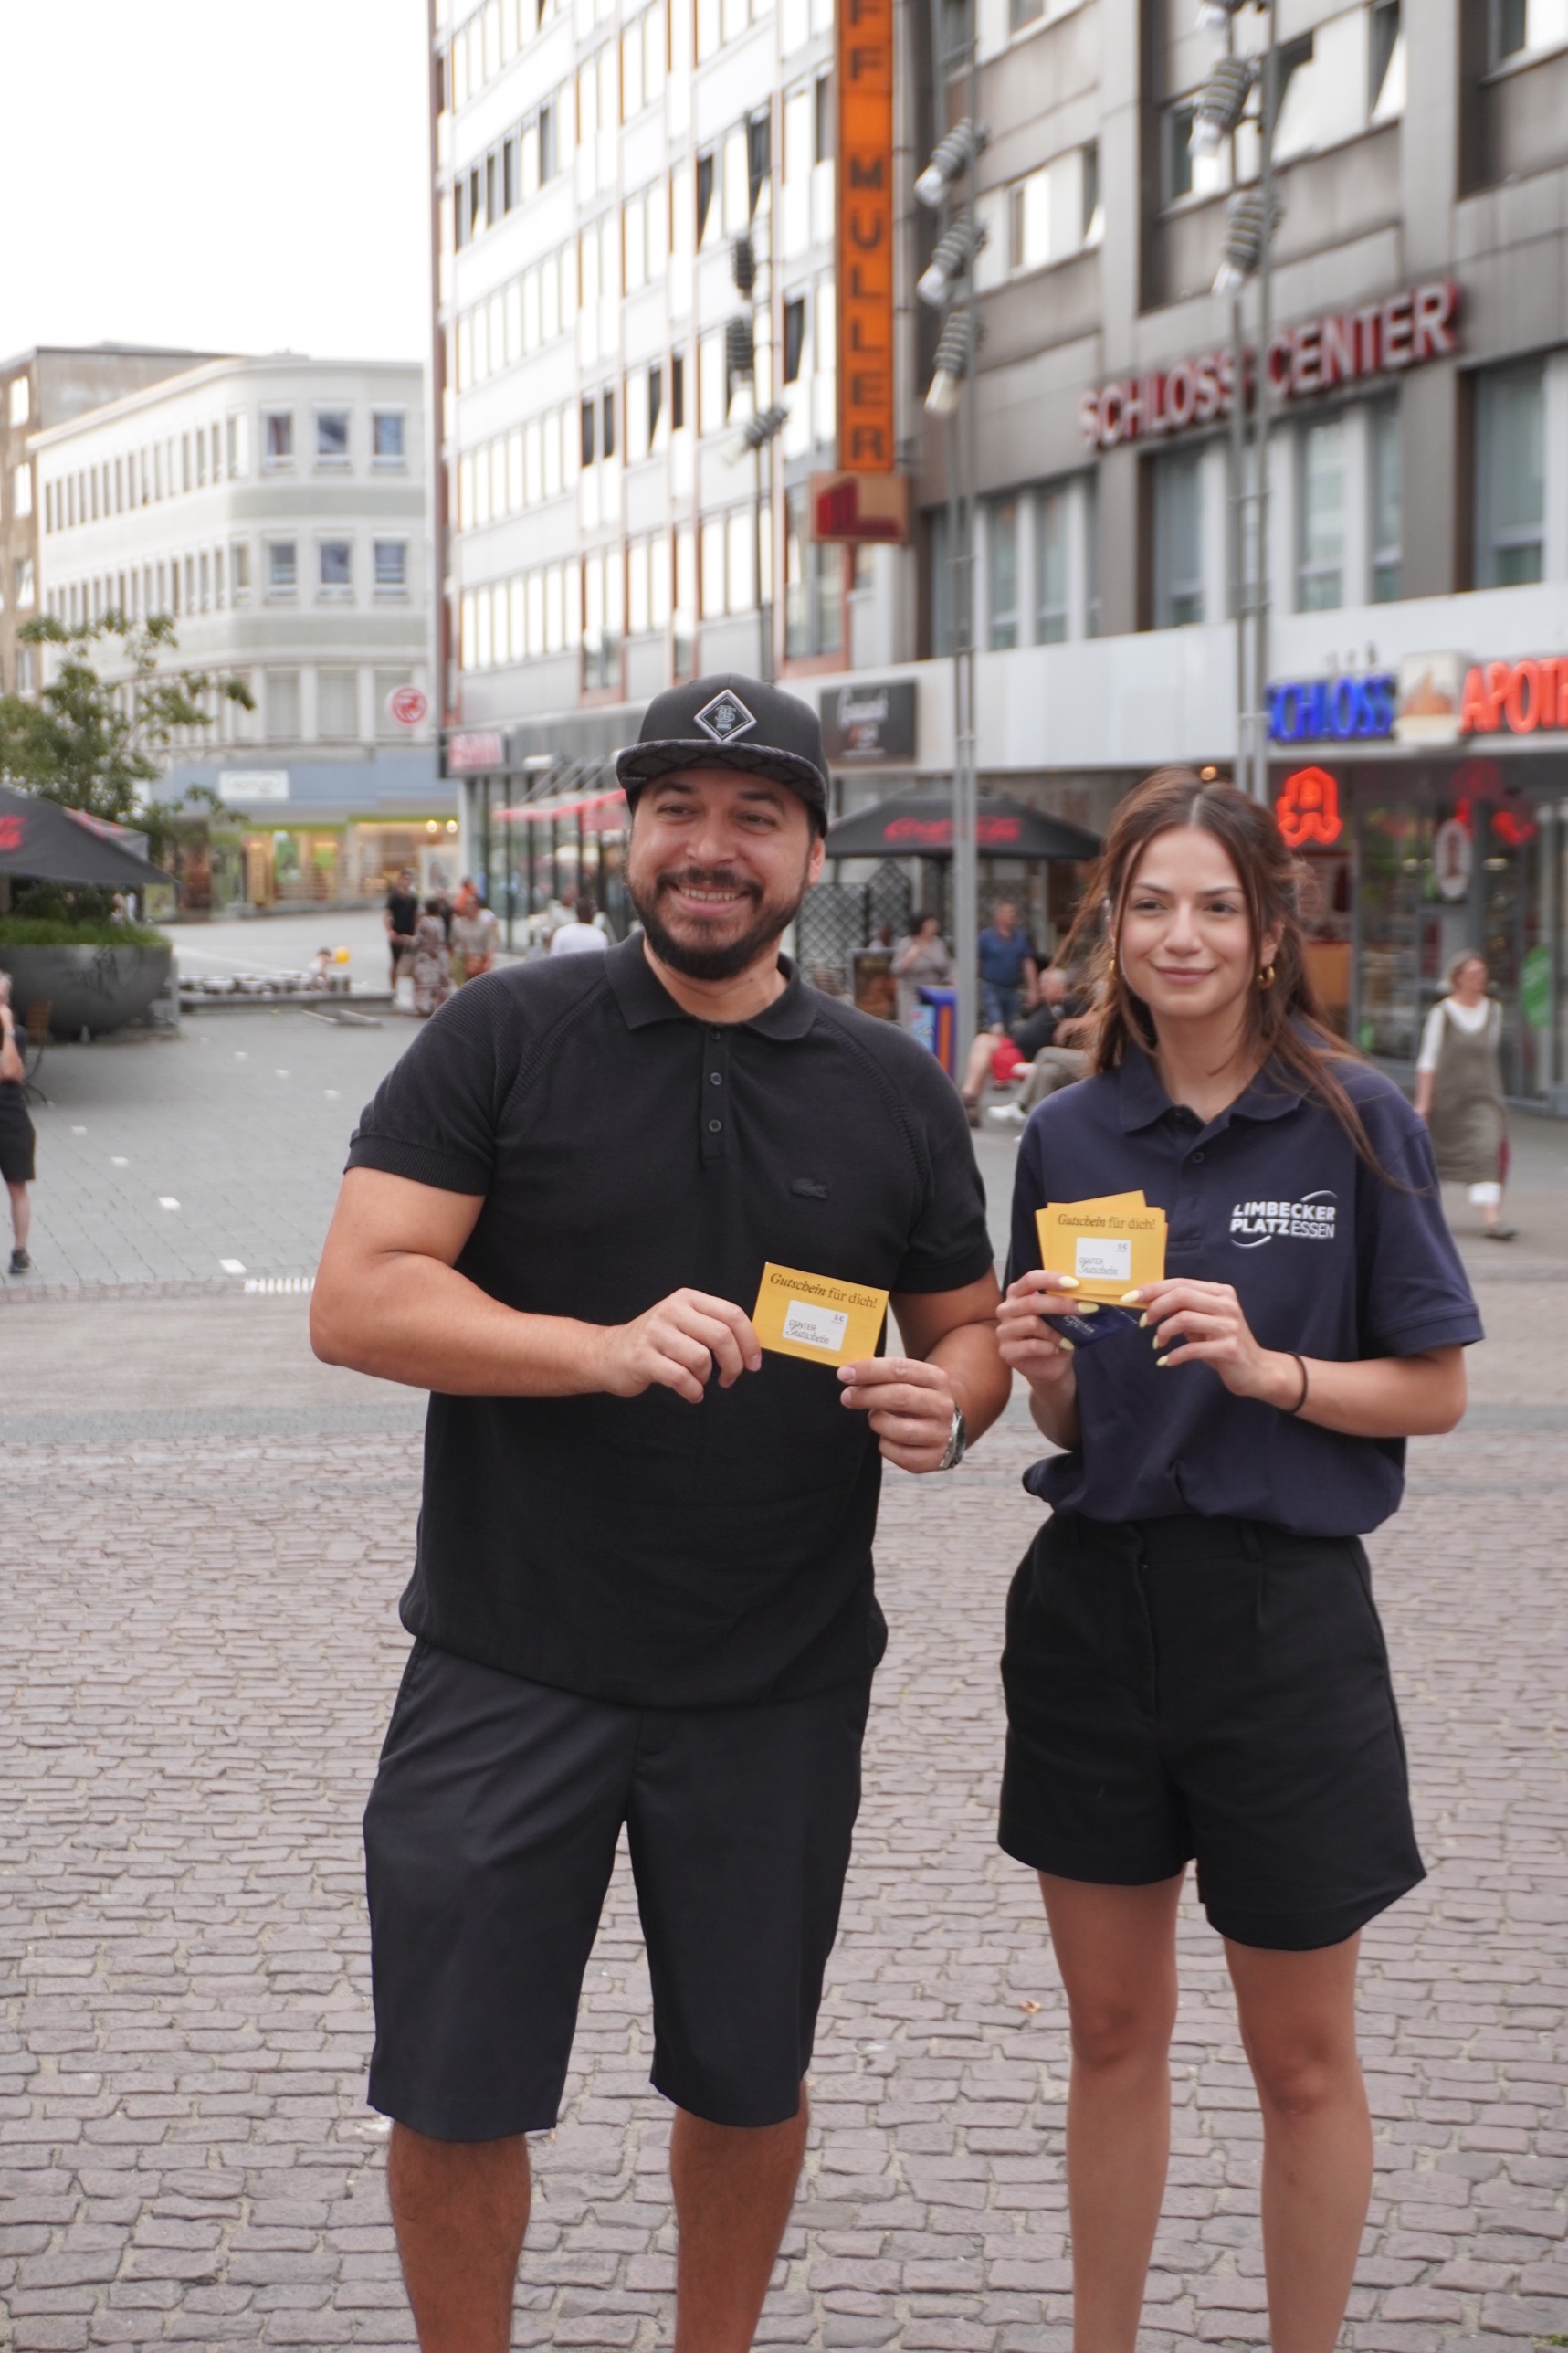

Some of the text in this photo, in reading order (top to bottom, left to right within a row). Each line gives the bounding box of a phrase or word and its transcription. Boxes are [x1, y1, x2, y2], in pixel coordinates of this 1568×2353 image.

[1266, 281, 1459, 400] CENTER
[1058, 1213, 1156, 1230] Gutschein für dich!
[1232, 1201, 1336, 1221] LIMBECKER
[770, 1272, 879, 1309] Gutschein für dich!
